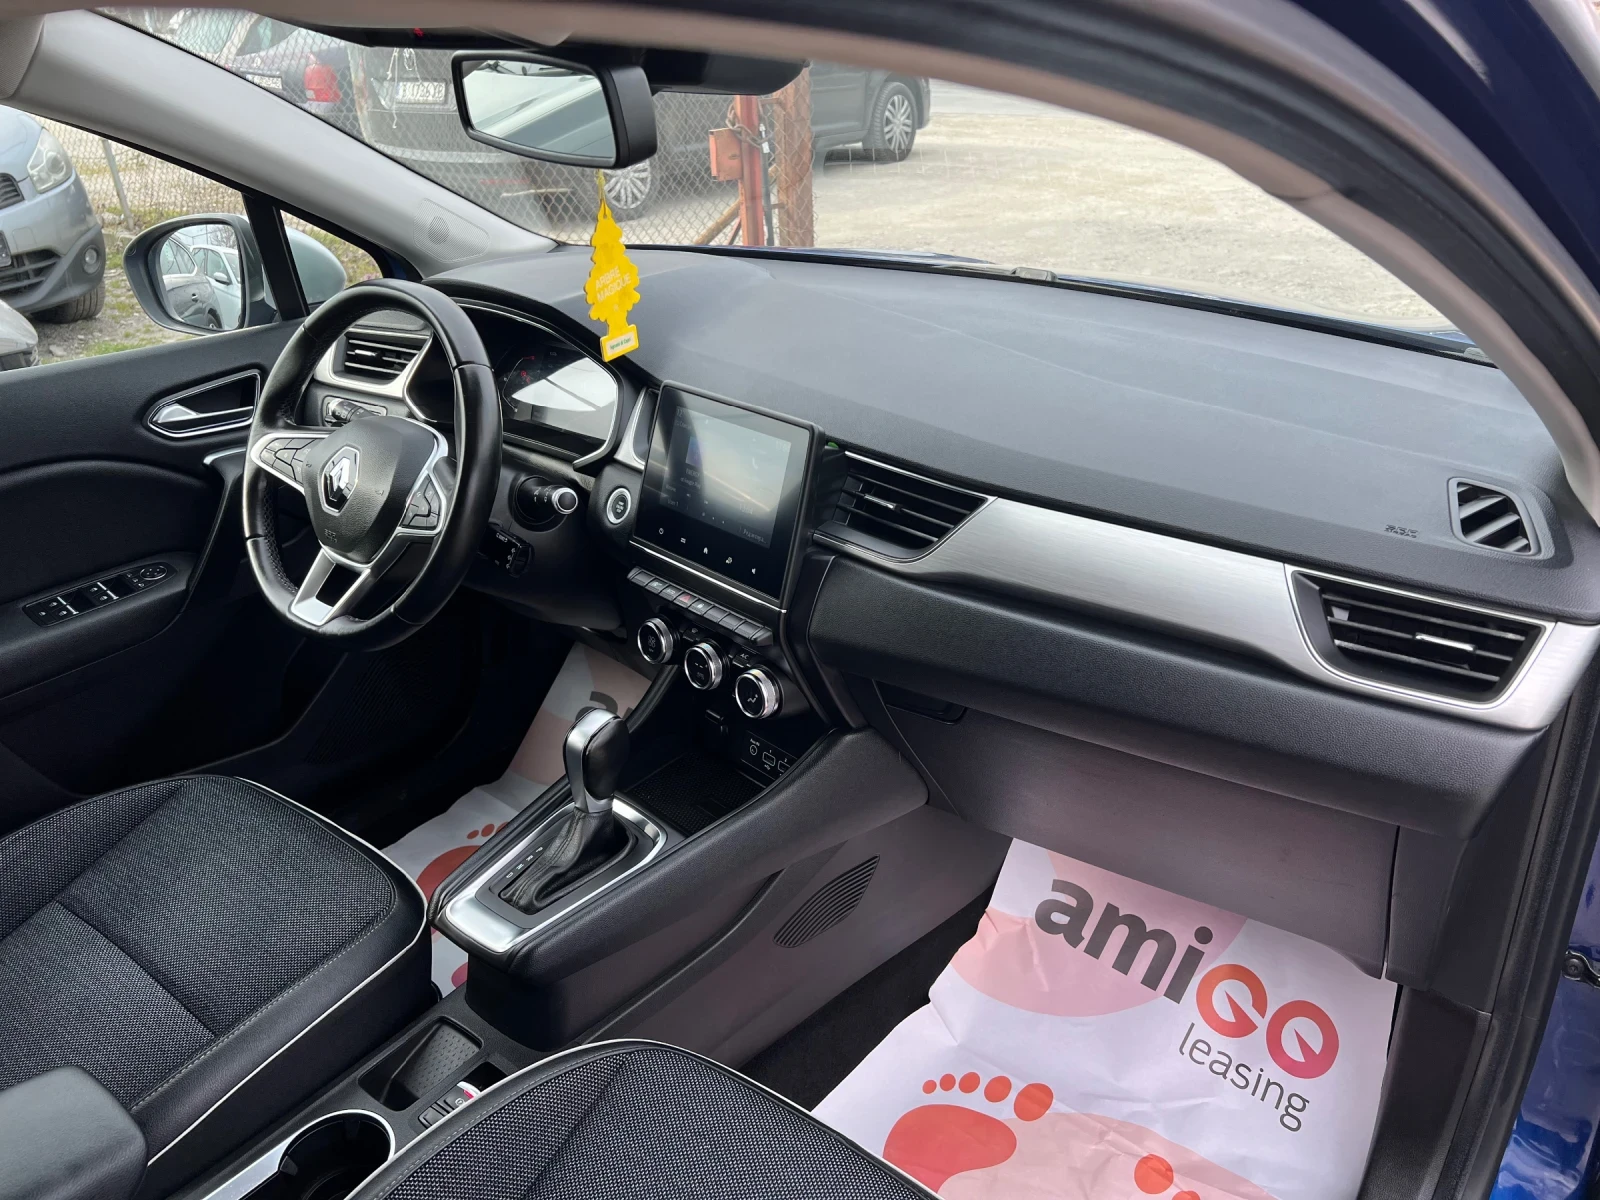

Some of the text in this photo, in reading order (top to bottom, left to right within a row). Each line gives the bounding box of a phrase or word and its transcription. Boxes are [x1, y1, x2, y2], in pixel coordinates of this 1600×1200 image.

[595, 265, 620, 290] ARBRE
[597, 272, 631, 302] MAGIQUE
[1178, 1022, 1310, 1133] leasing
